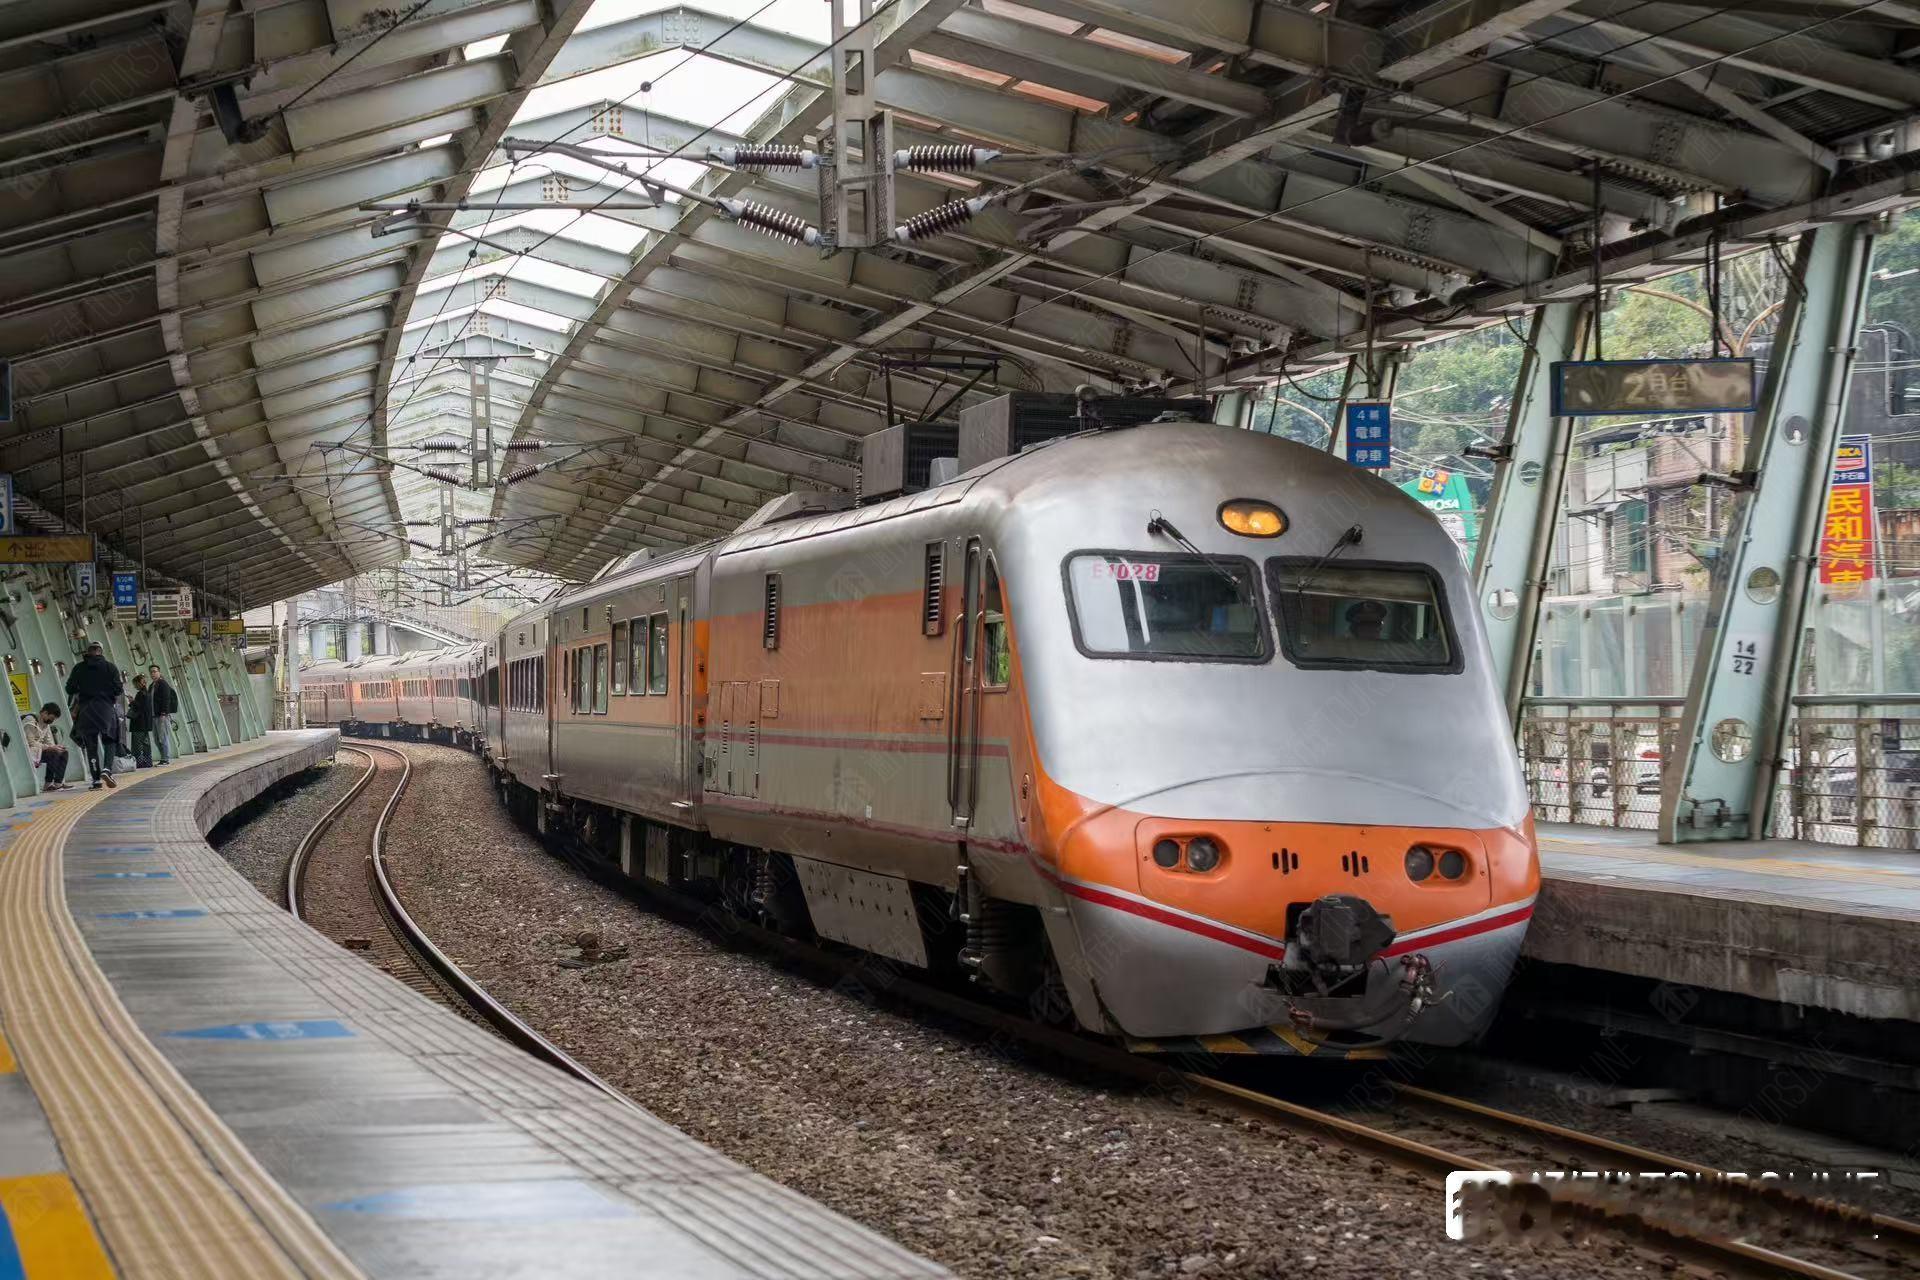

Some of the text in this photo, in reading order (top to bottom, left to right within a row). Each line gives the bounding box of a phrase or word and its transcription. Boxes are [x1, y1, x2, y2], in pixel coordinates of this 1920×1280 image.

[1355, 449, 1382, 463] 停車
[1826, 487, 1865, 596] 民和汽車
[80, 575, 91, 596] 5
[1736, 640, 1756, 655] 14
[1733, 659, 1754, 675] 22
